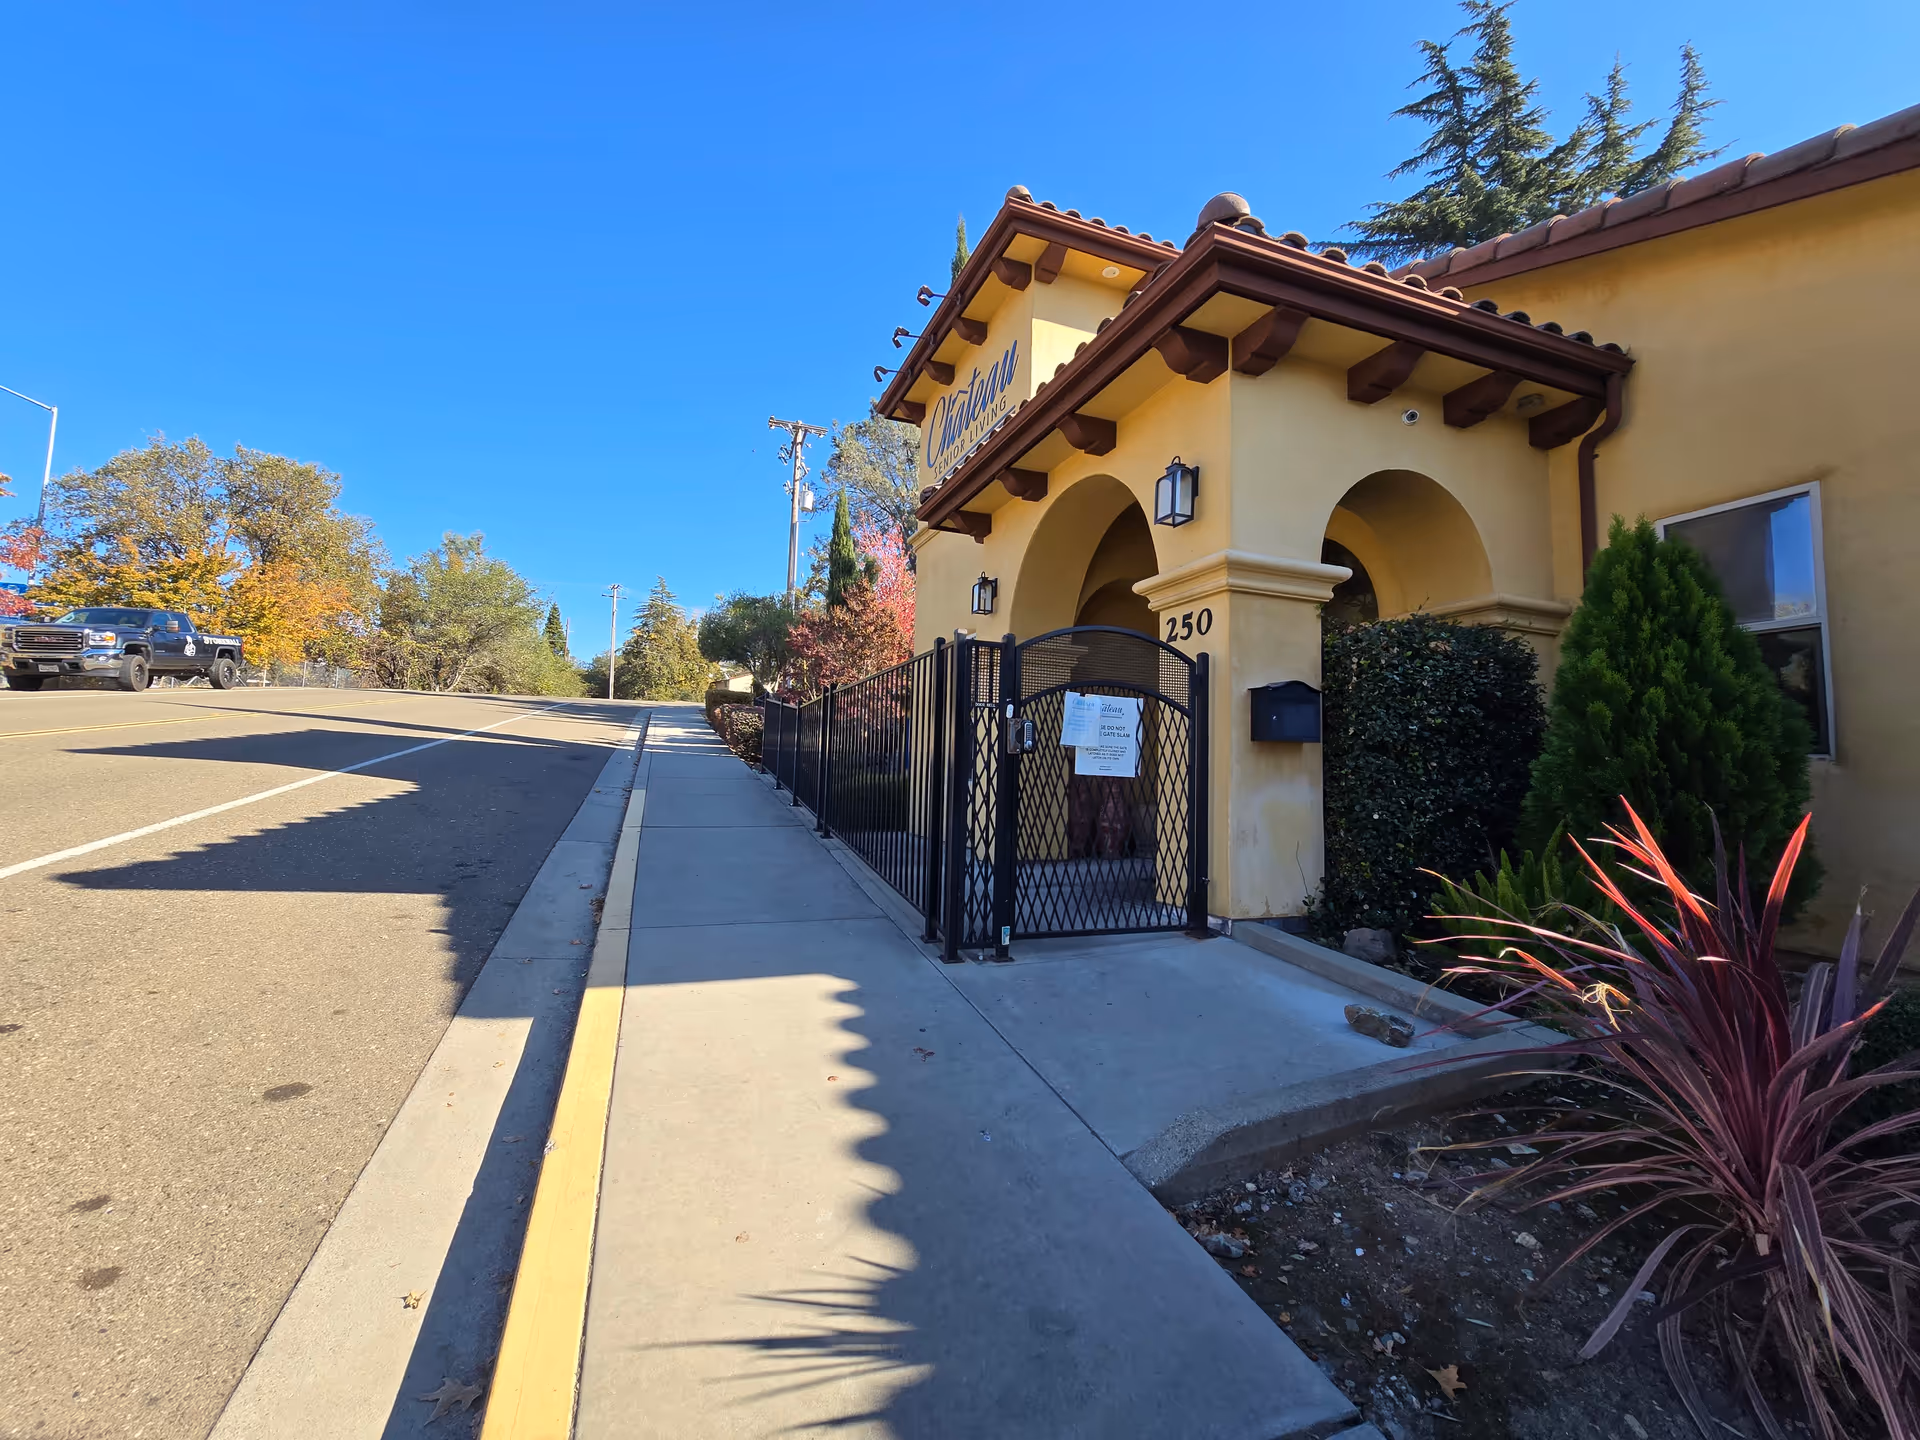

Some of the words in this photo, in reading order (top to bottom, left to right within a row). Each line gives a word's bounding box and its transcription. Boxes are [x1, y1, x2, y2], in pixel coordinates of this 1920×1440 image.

[934, 439, 965, 479] SENIOR
[969, 395, 1007, 442] LIVING
[1165, 608, 1213, 643] 250
